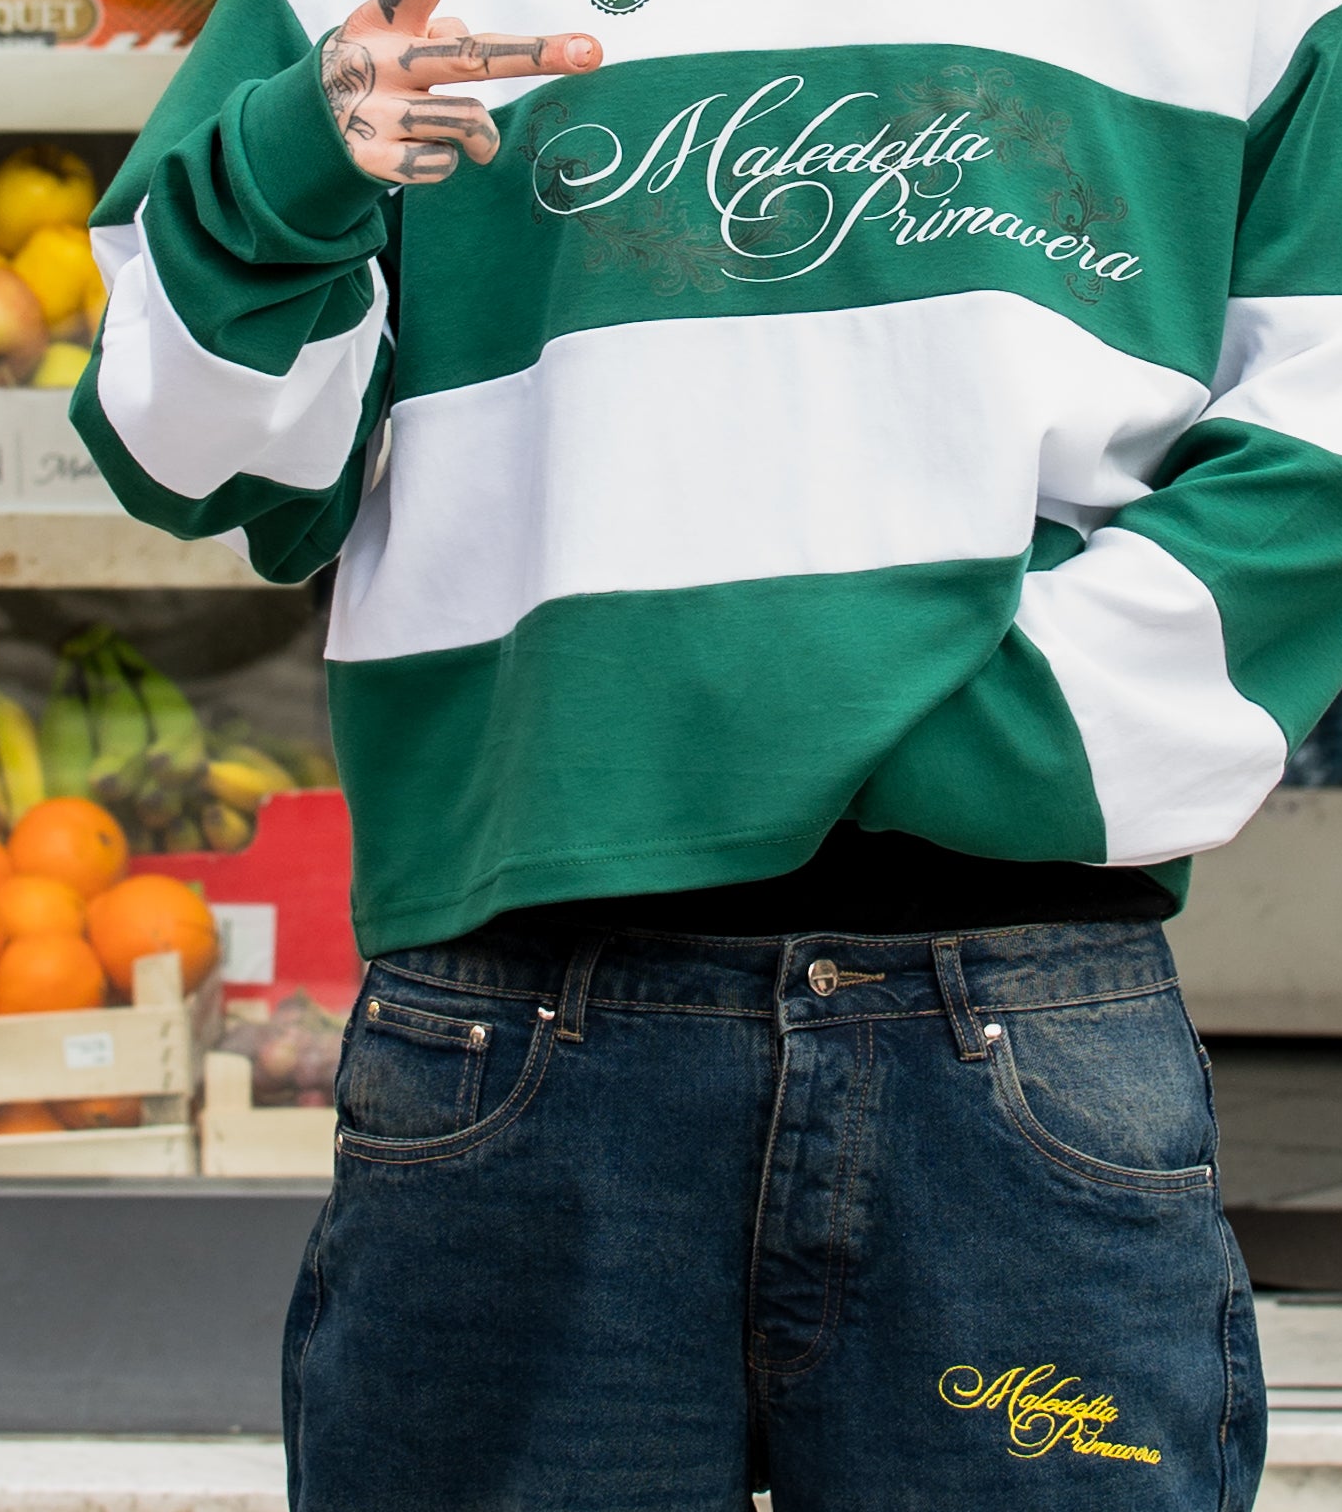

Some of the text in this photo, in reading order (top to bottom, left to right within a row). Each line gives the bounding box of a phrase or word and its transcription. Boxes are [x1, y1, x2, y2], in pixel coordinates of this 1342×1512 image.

[531, 74, 994, 221] Maledetta
[719, 162, 1145, 284] Primavera
[938, 1363, 1120, 1425] Maledetta
[1007, 1412, 1162, 1466] Primavera
